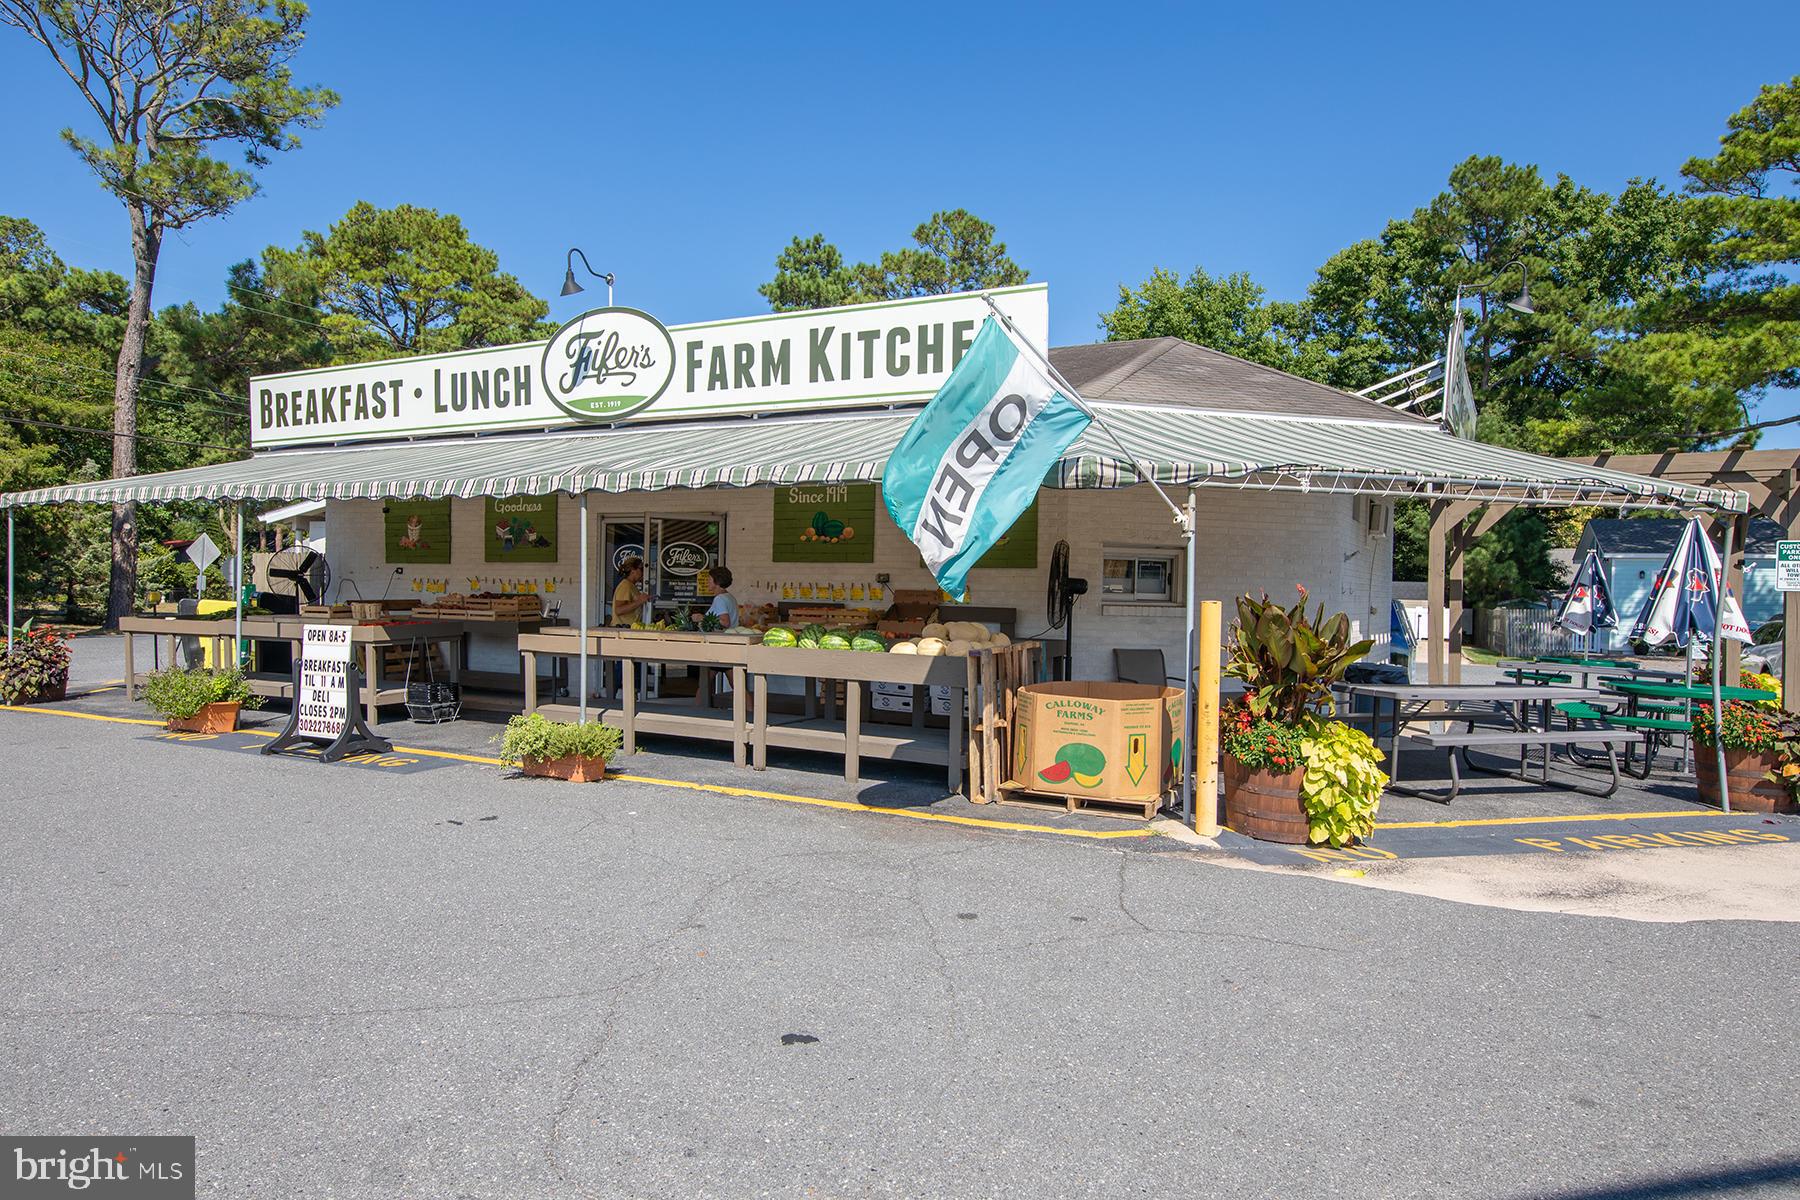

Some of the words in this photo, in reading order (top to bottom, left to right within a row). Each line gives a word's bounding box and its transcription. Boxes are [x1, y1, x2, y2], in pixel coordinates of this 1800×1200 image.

[687, 339, 791, 392] FARM
[809, 316, 1013, 383] KITCHE
[560, 331, 656, 394] Fifer's
[260, 379, 404, 429] BREAKFAST
[434, 365, 532, 413] LUNCH
[590, 401, 606, 409] EST.
[608, 400, 621, 408] 1919
[788, 488, 824, 504] Since
[826, 486, 848, 503] 1919
[494, 498, 543, 514] Goodness
[1721, 623, 1735, 631] OT
[307, 629, 326, 643] OPEN
[328, 629, 346, 643] 8A-5
[304, 659, 346, 673] BREAKFAST
[305, 675, 316, 687] TIL
[312, 690, 330, 703] DELI
[299, 703, 328, 718] CLOSES
[329, 706, 346, 720] 2PM
[1045, 699, 1106, 716] CALLOWAY
[1056, 710, 1094, 721] FARMS
[1514, 829, 1790, 851] PARKING
